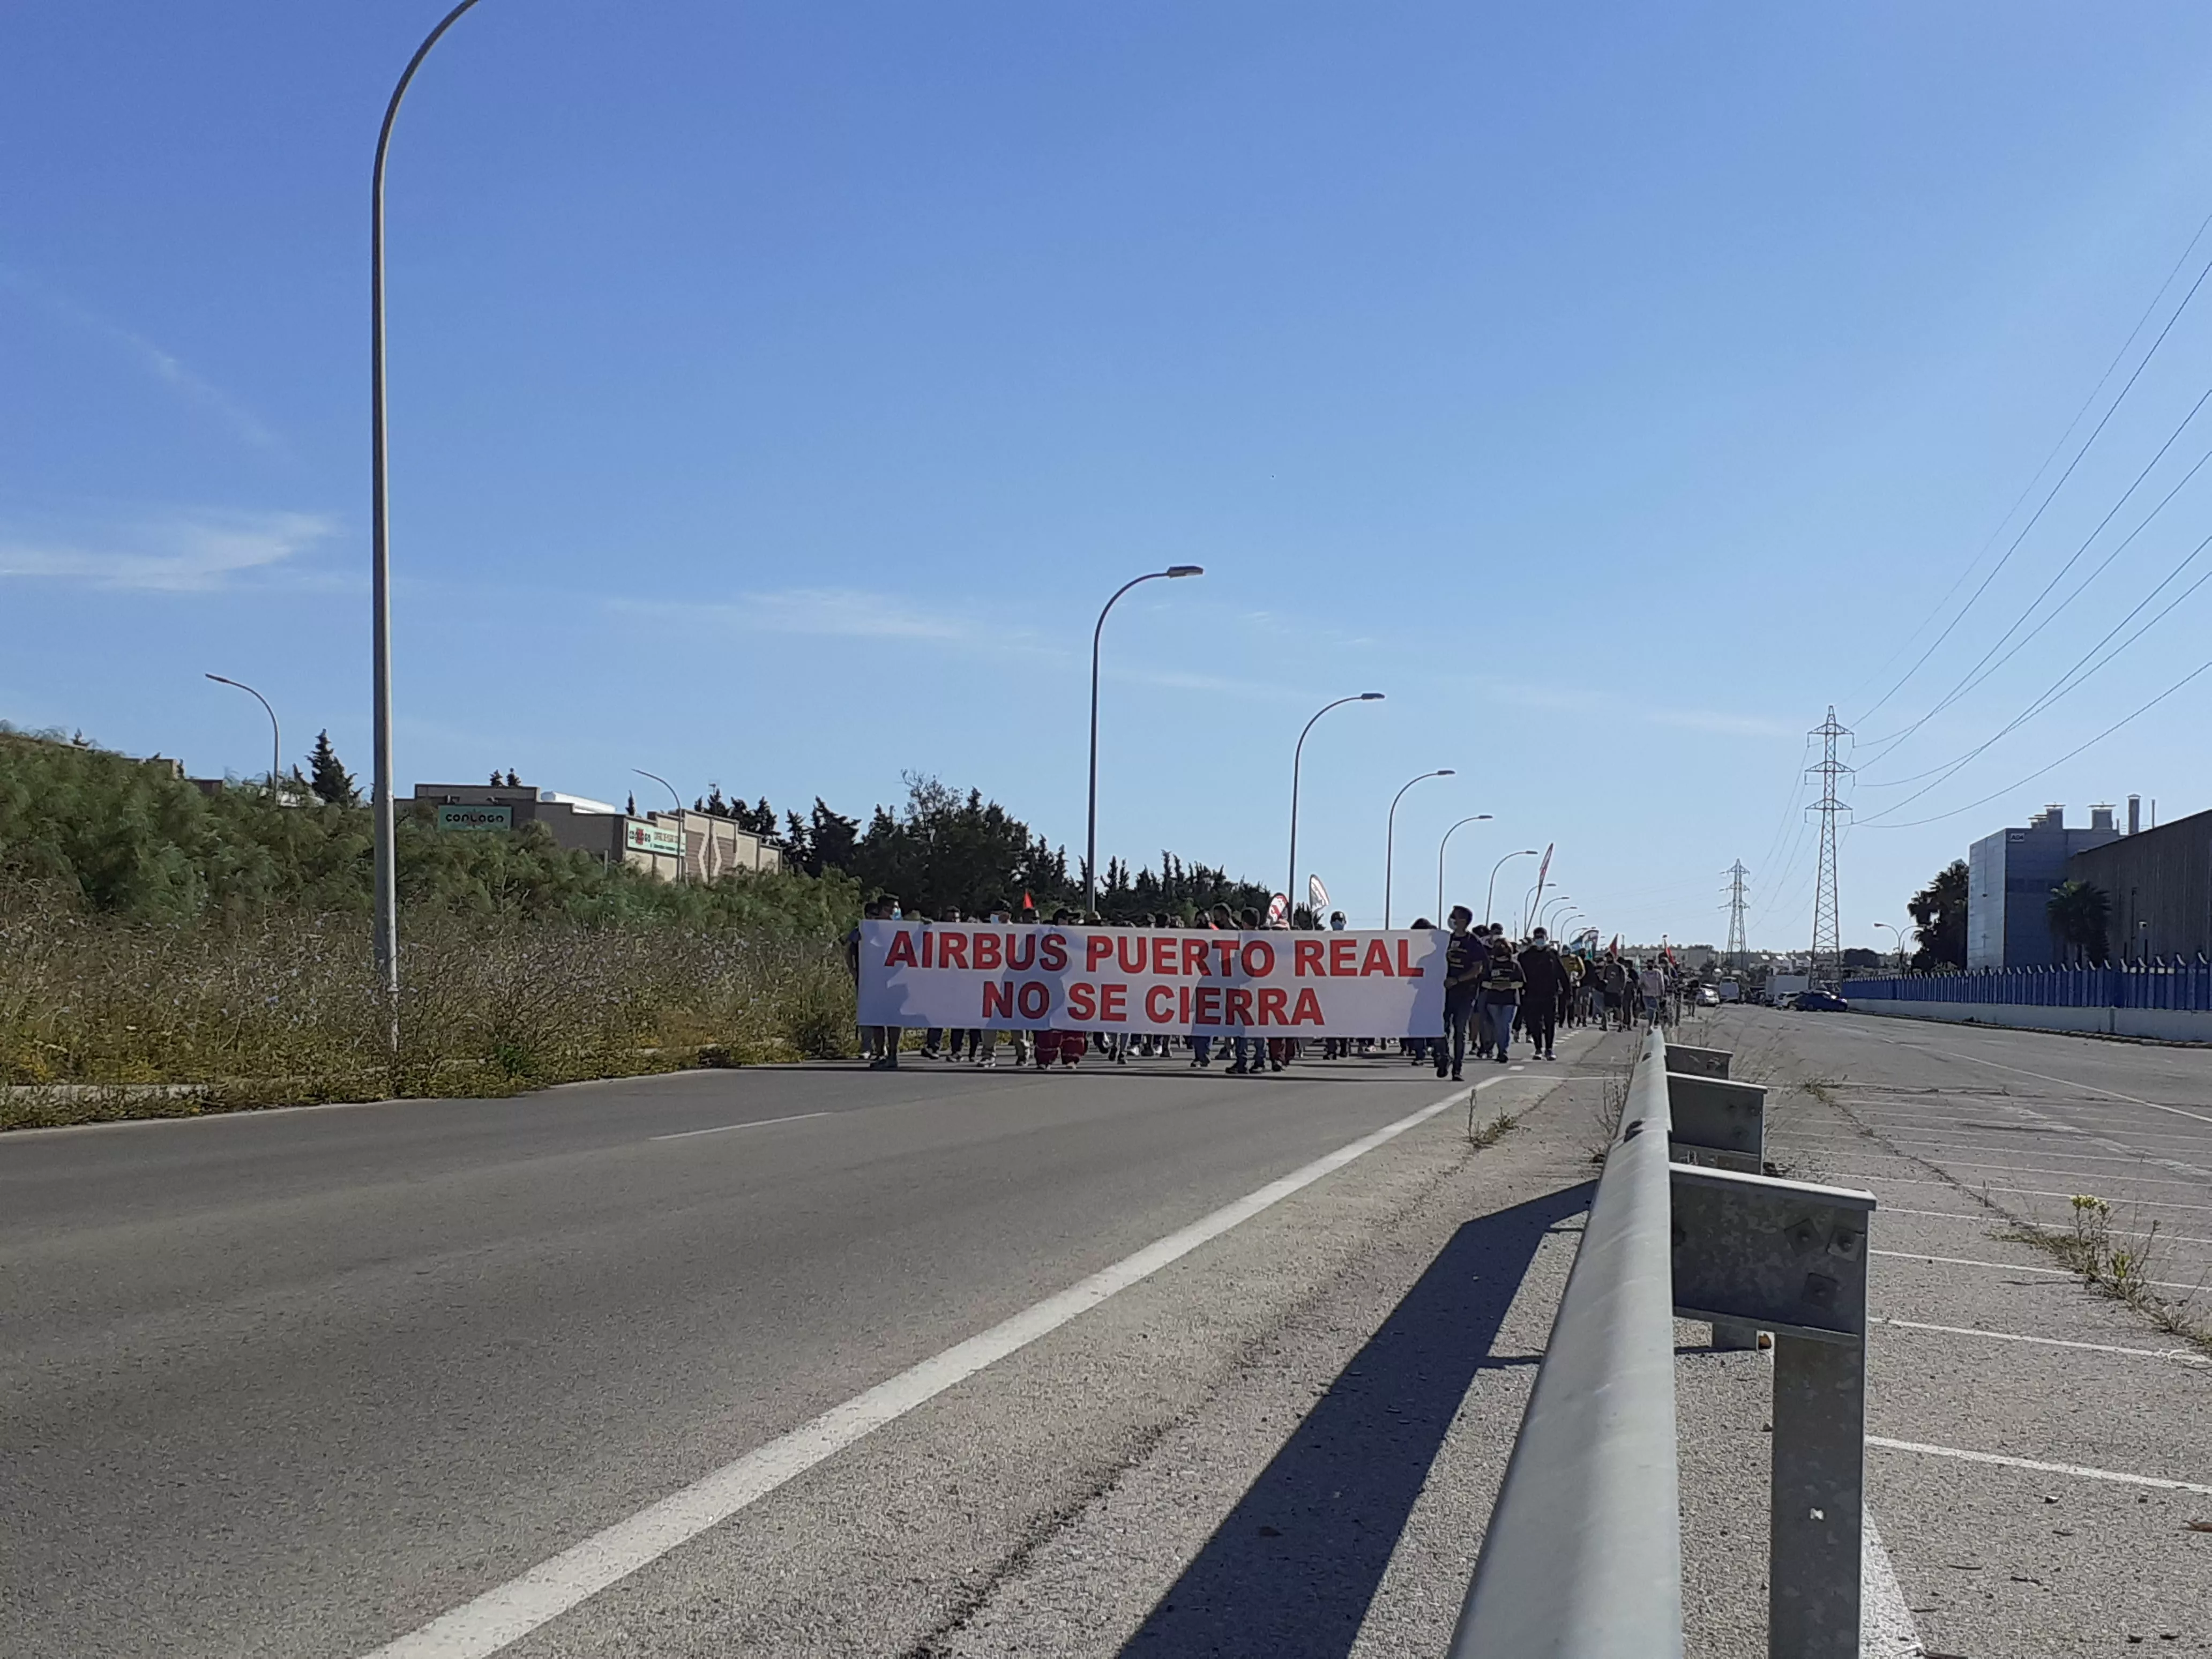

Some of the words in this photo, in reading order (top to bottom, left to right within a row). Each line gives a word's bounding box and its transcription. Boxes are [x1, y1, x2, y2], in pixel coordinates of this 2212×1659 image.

[885, 930, 1067, 971] AIRBUS
[1086, 935, 1275, 978] PUERTO
[1295, 939, 1424, 977] REAL
[982, 981, 1050, 1019] NO
[1067, 982, 1127, 1021] SE
[1145, 985, 1325, 1026] CIERRA
